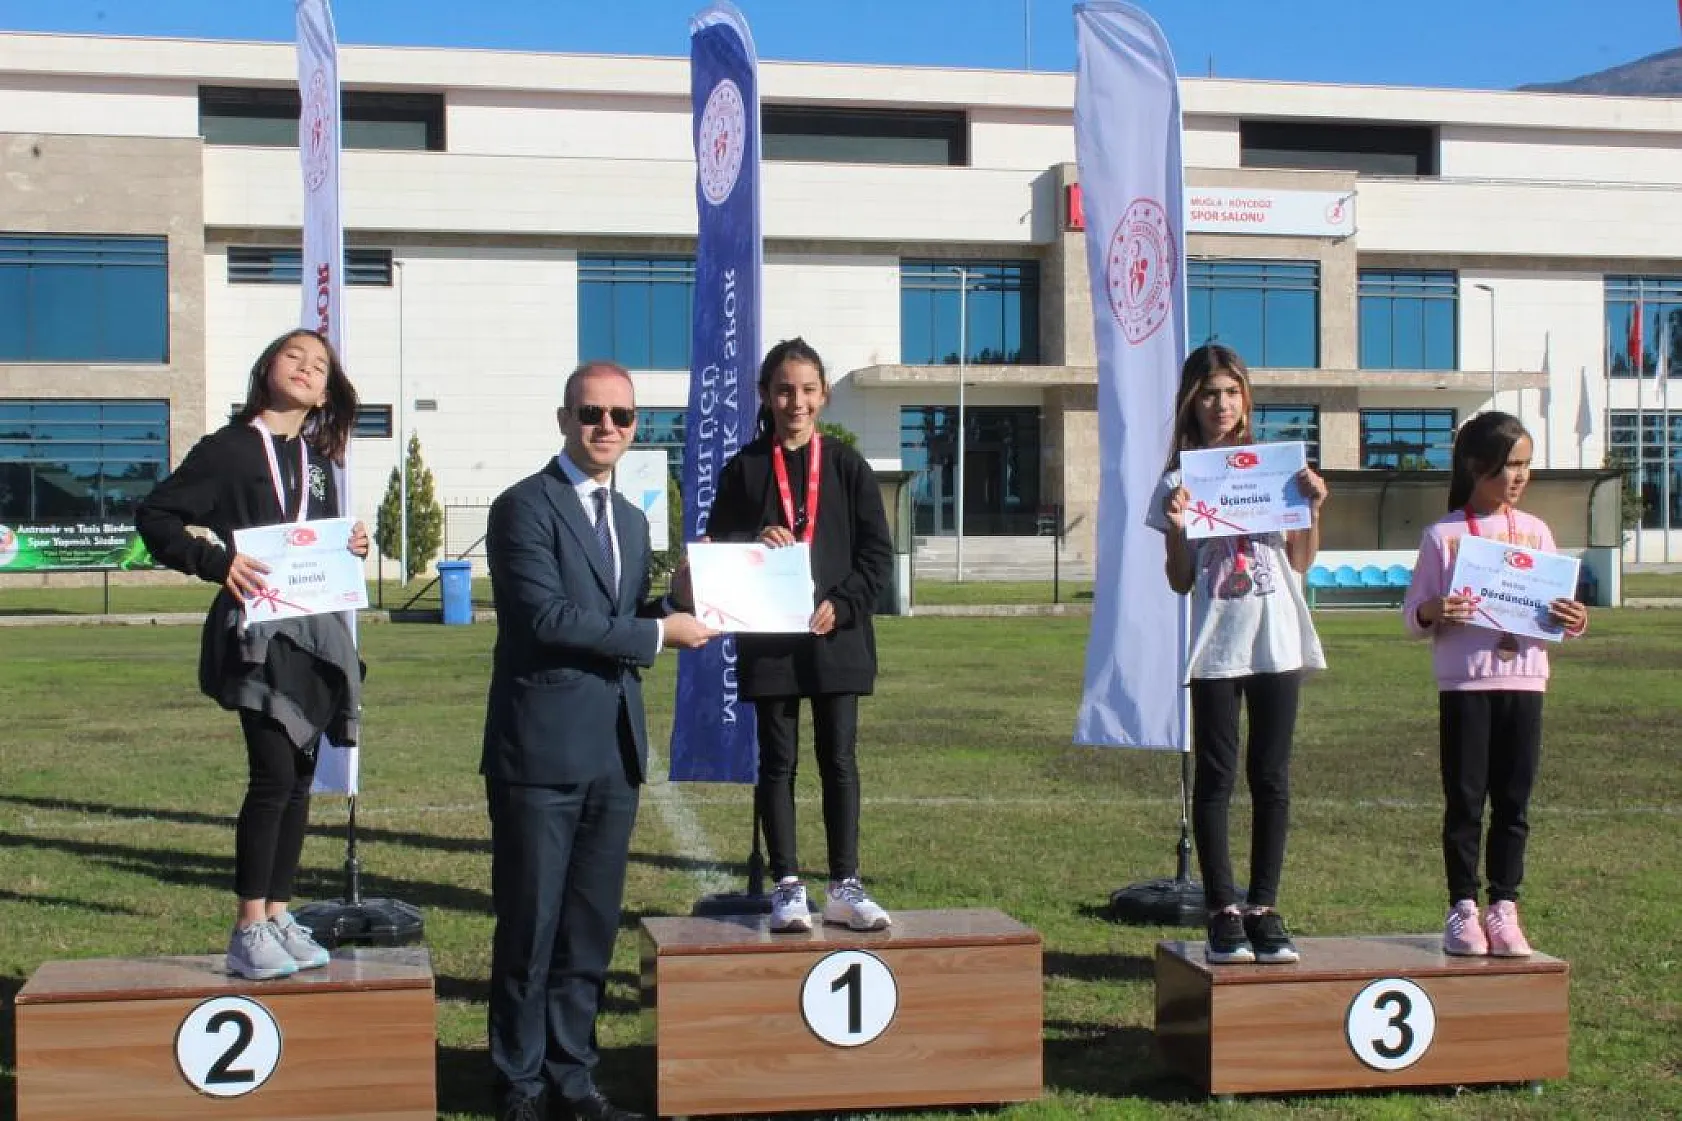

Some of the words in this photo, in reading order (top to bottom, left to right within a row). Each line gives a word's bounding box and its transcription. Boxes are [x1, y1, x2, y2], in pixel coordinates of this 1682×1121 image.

[1190, 210, 1219, 221] SPOR
[1220, 211, 1265, 223] SALONU
[829, 963, 862, 1034] 1
[1371, 990, 1414, 1059] 3
[204, 1009, 255, 1085] 2
